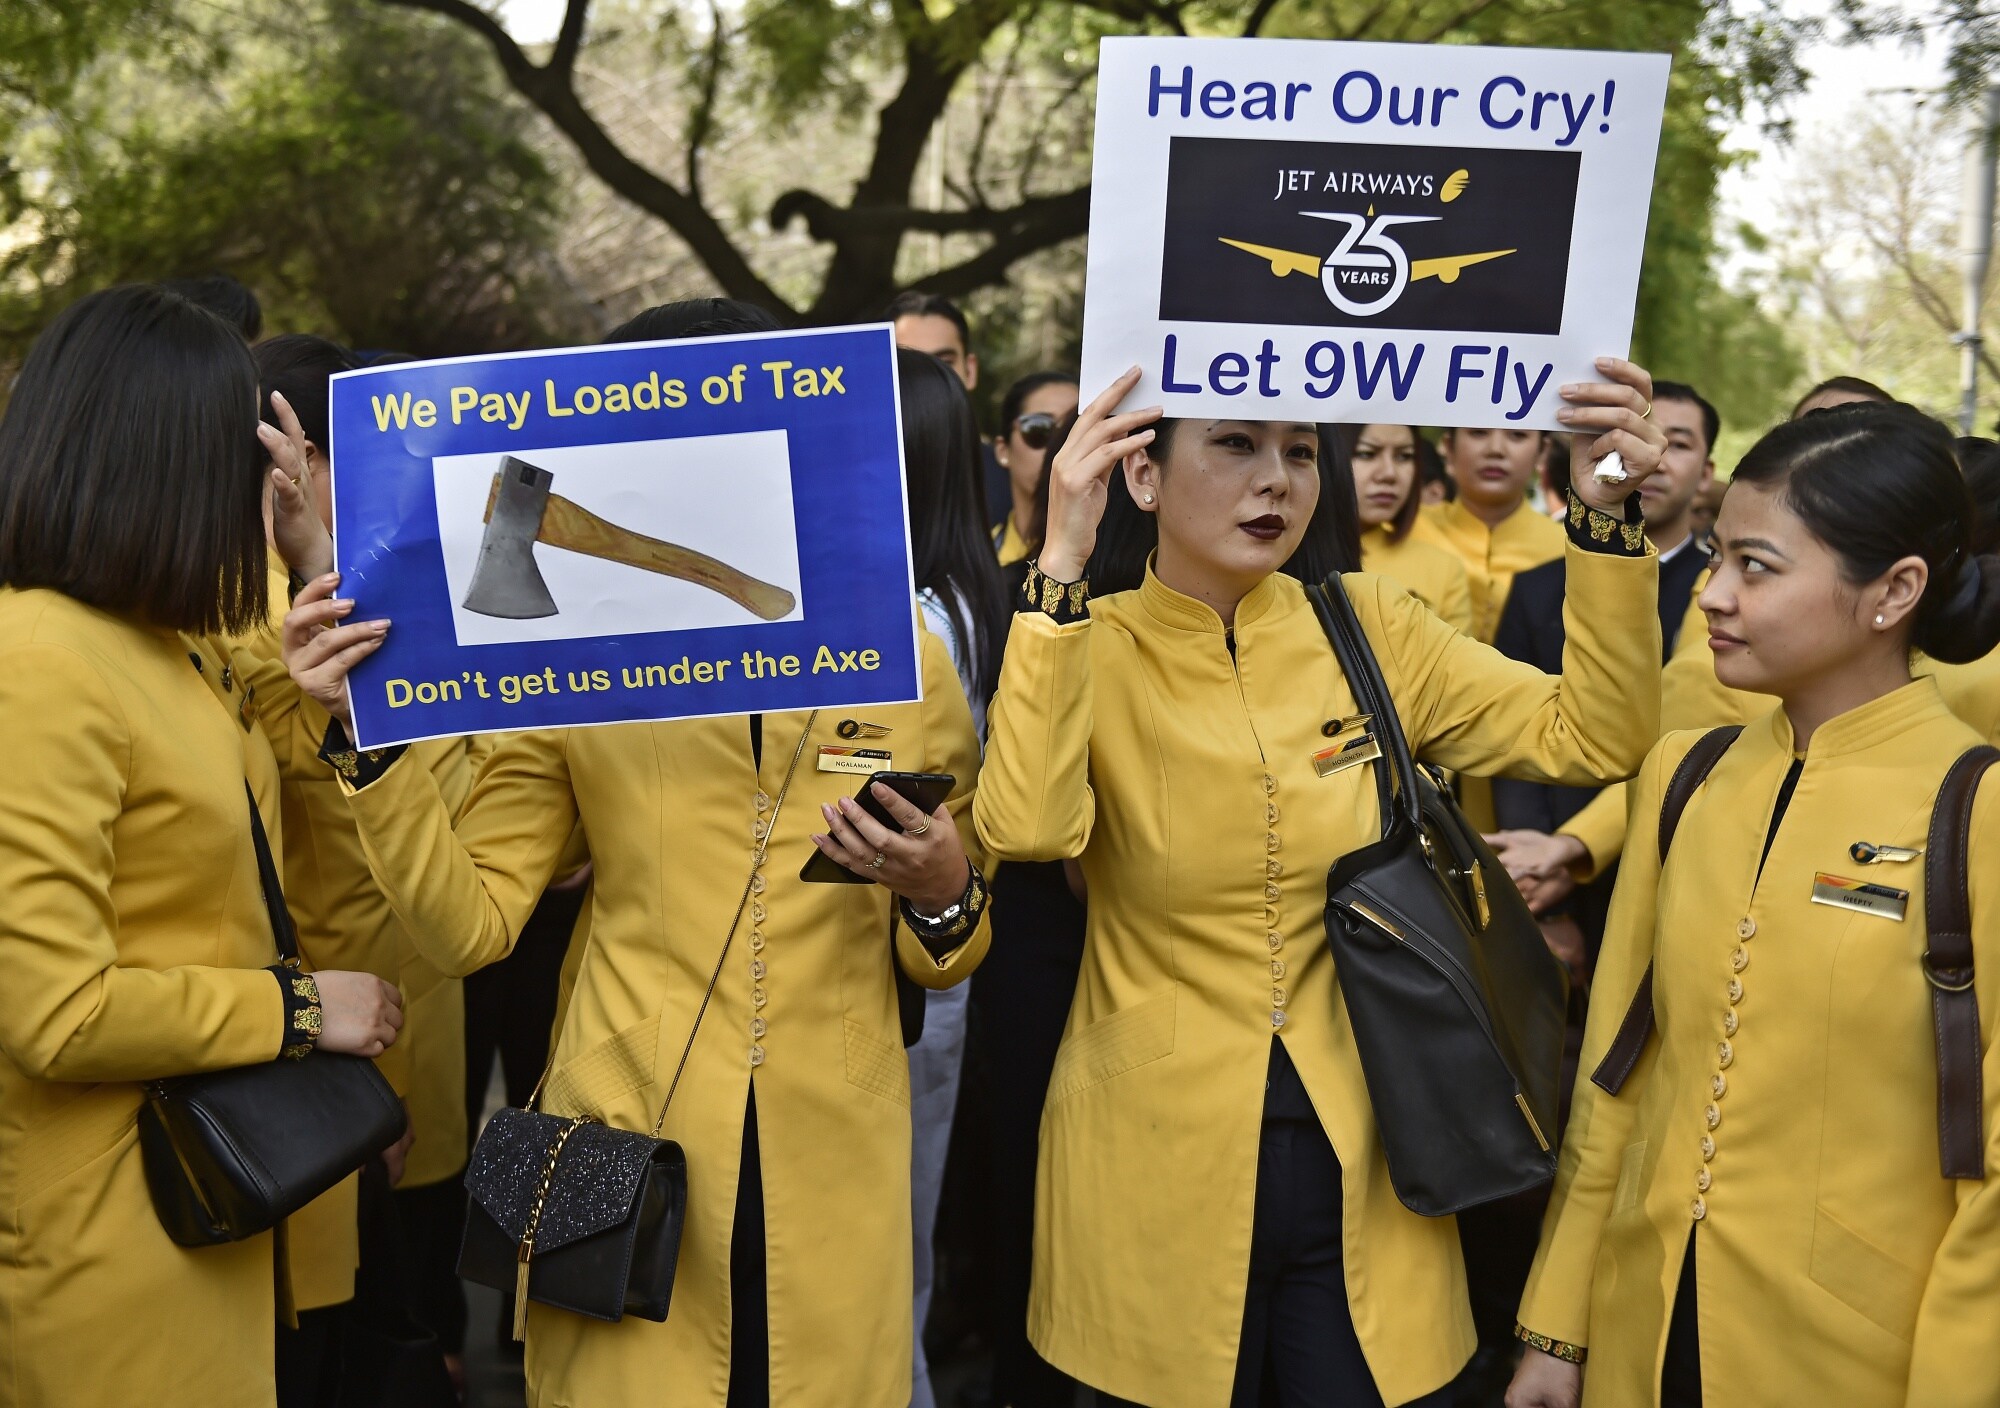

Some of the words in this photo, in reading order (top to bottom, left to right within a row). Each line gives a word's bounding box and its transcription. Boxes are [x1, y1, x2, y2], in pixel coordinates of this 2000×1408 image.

[1148, 65, 1312, 122] Hear
[1332, 70, 1460, 127] Our
[1479, 76, 1617, 147] Cry!
[1273, 169, 1316, 201] JET
[1323, 171, 1434, 197] AIRWAYS
[1299, 211, 1443, 317] 25
[1340, 270, 1389, 285] YEARS
[372, 393, 437, 432] We
[451, 387, 531, 430] Pay
[545, 371, 688, 417] Loads
[701, 364, 747, 405] of
[762, 361, 846, 399] Tax
[1161, 334, 1281, 398] Let
[1304, 340, 1425, 402] 9W
[1445, 345, 1554, 421] Fly
[385, 670, 490, 708] Don't
[498, 667, 560, 704] get
[568, 669, 611, 693] us
[622, 656, 731, 689] under
[741, 650, 800, 679] the
[812, 645, 880, 674] Axe
[835, 761, 872, 769] NGALAMAN
